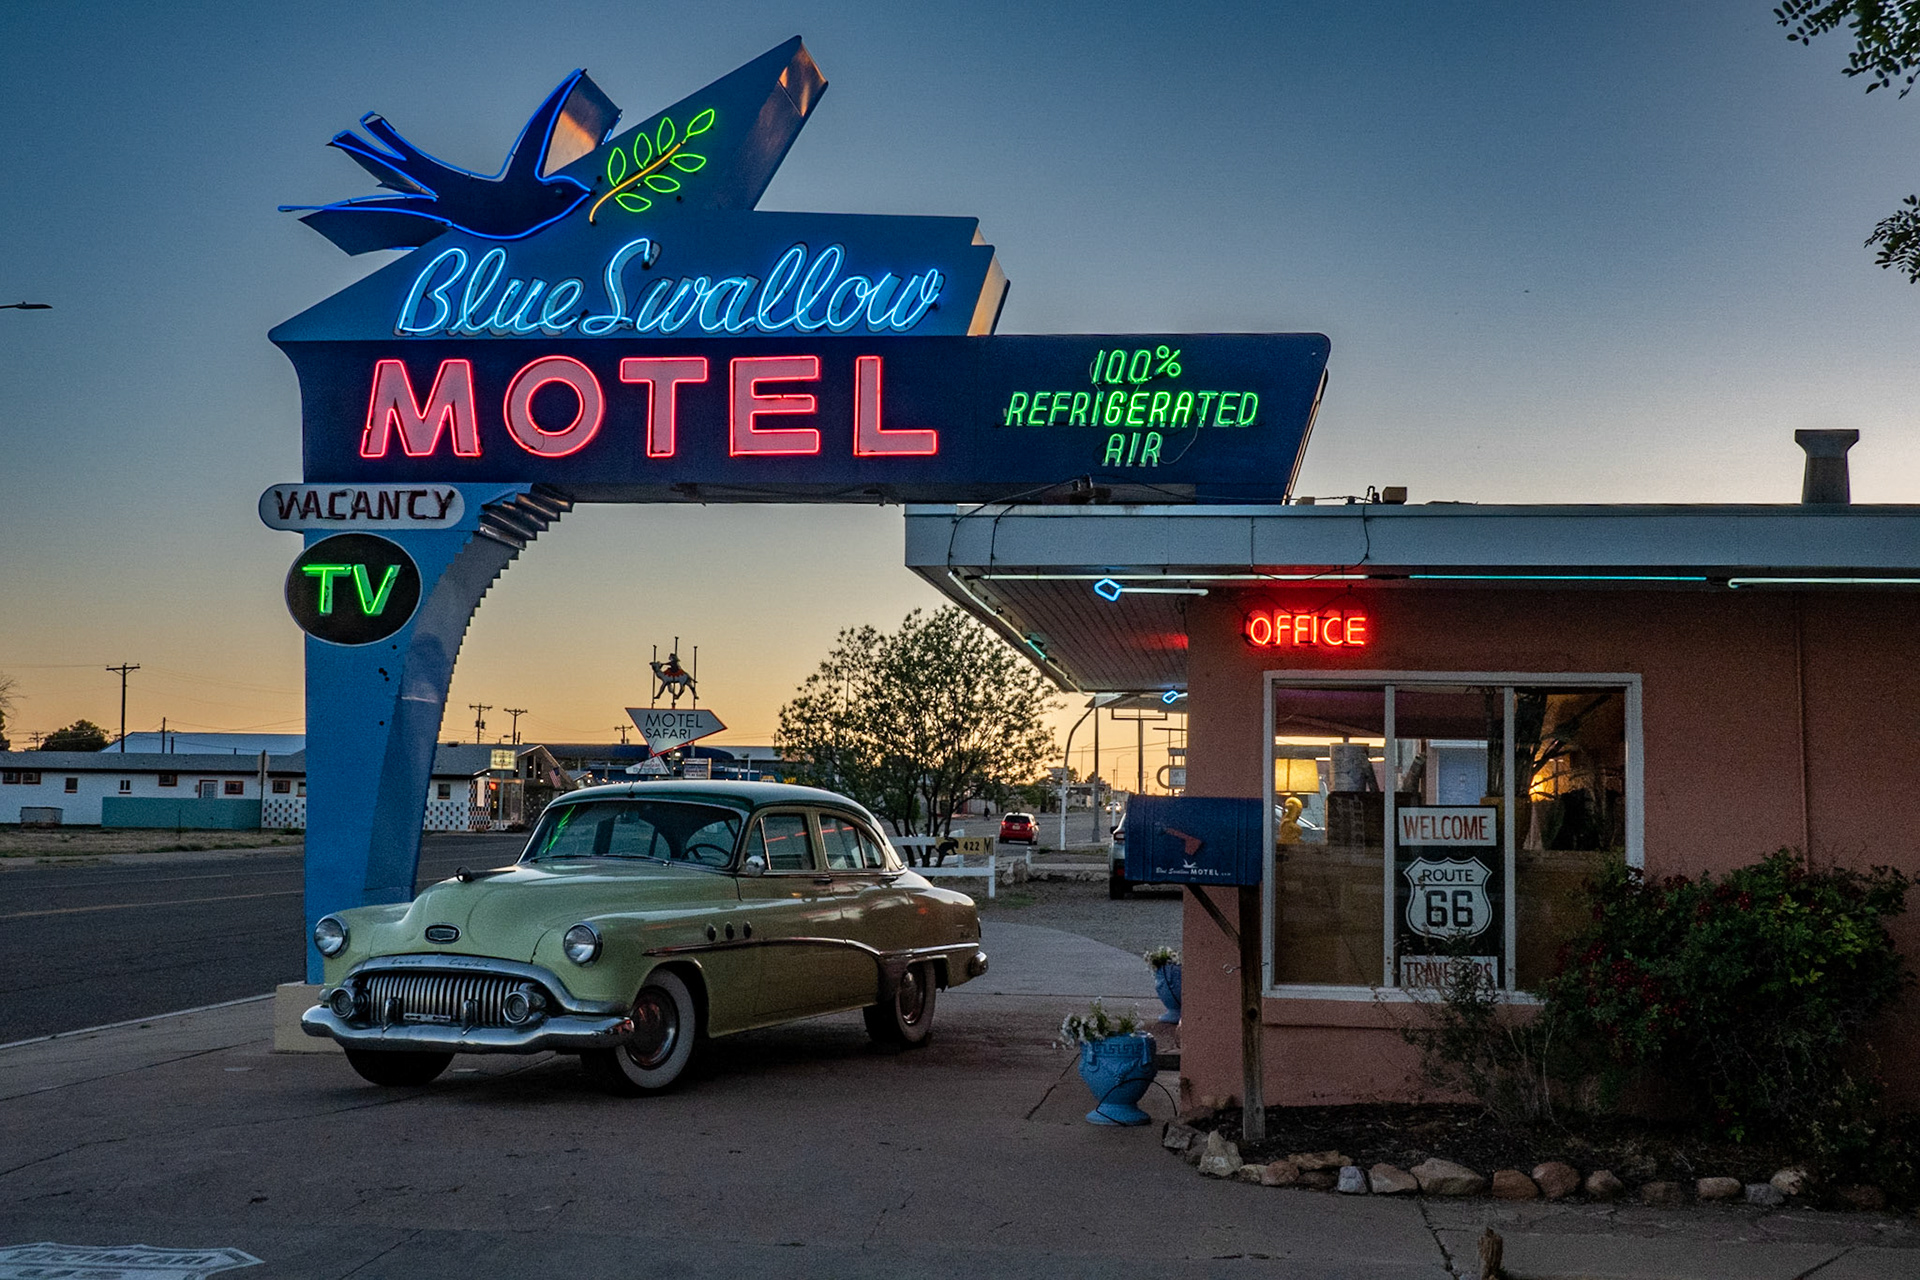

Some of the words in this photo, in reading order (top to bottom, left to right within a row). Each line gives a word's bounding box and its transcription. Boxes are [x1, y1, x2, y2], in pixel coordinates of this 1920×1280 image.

[395, 245, 586, 337] Blue
[579, 237, 945, 337] Swallow
[1090, 345, 1182, 384] 100%
[359, 355, 939, 459] MOTEL
[1004, 390, 1259, 428] REFRIGERATED
[1101, 431, 1164, 468] AIR
[274, 488, 456, 521] VACANCY
[302, 563, 402, 616] TV
[1247, 611, 1367, 646] OFFICE
[645, 712, 704, 729] MOTEL
[645, 727, 691, 740] SAFARI
[1402, 814, 1490, 841] WELCOME
[963, 840, 980, 852] 422
[1190, 868, 1219, 877] MOTEL
[1422, 868, 1475, 883] ROUTE
[1425, 889, 1474, 928] 66
[1403, 961, 1494, 988] TRAVERS
